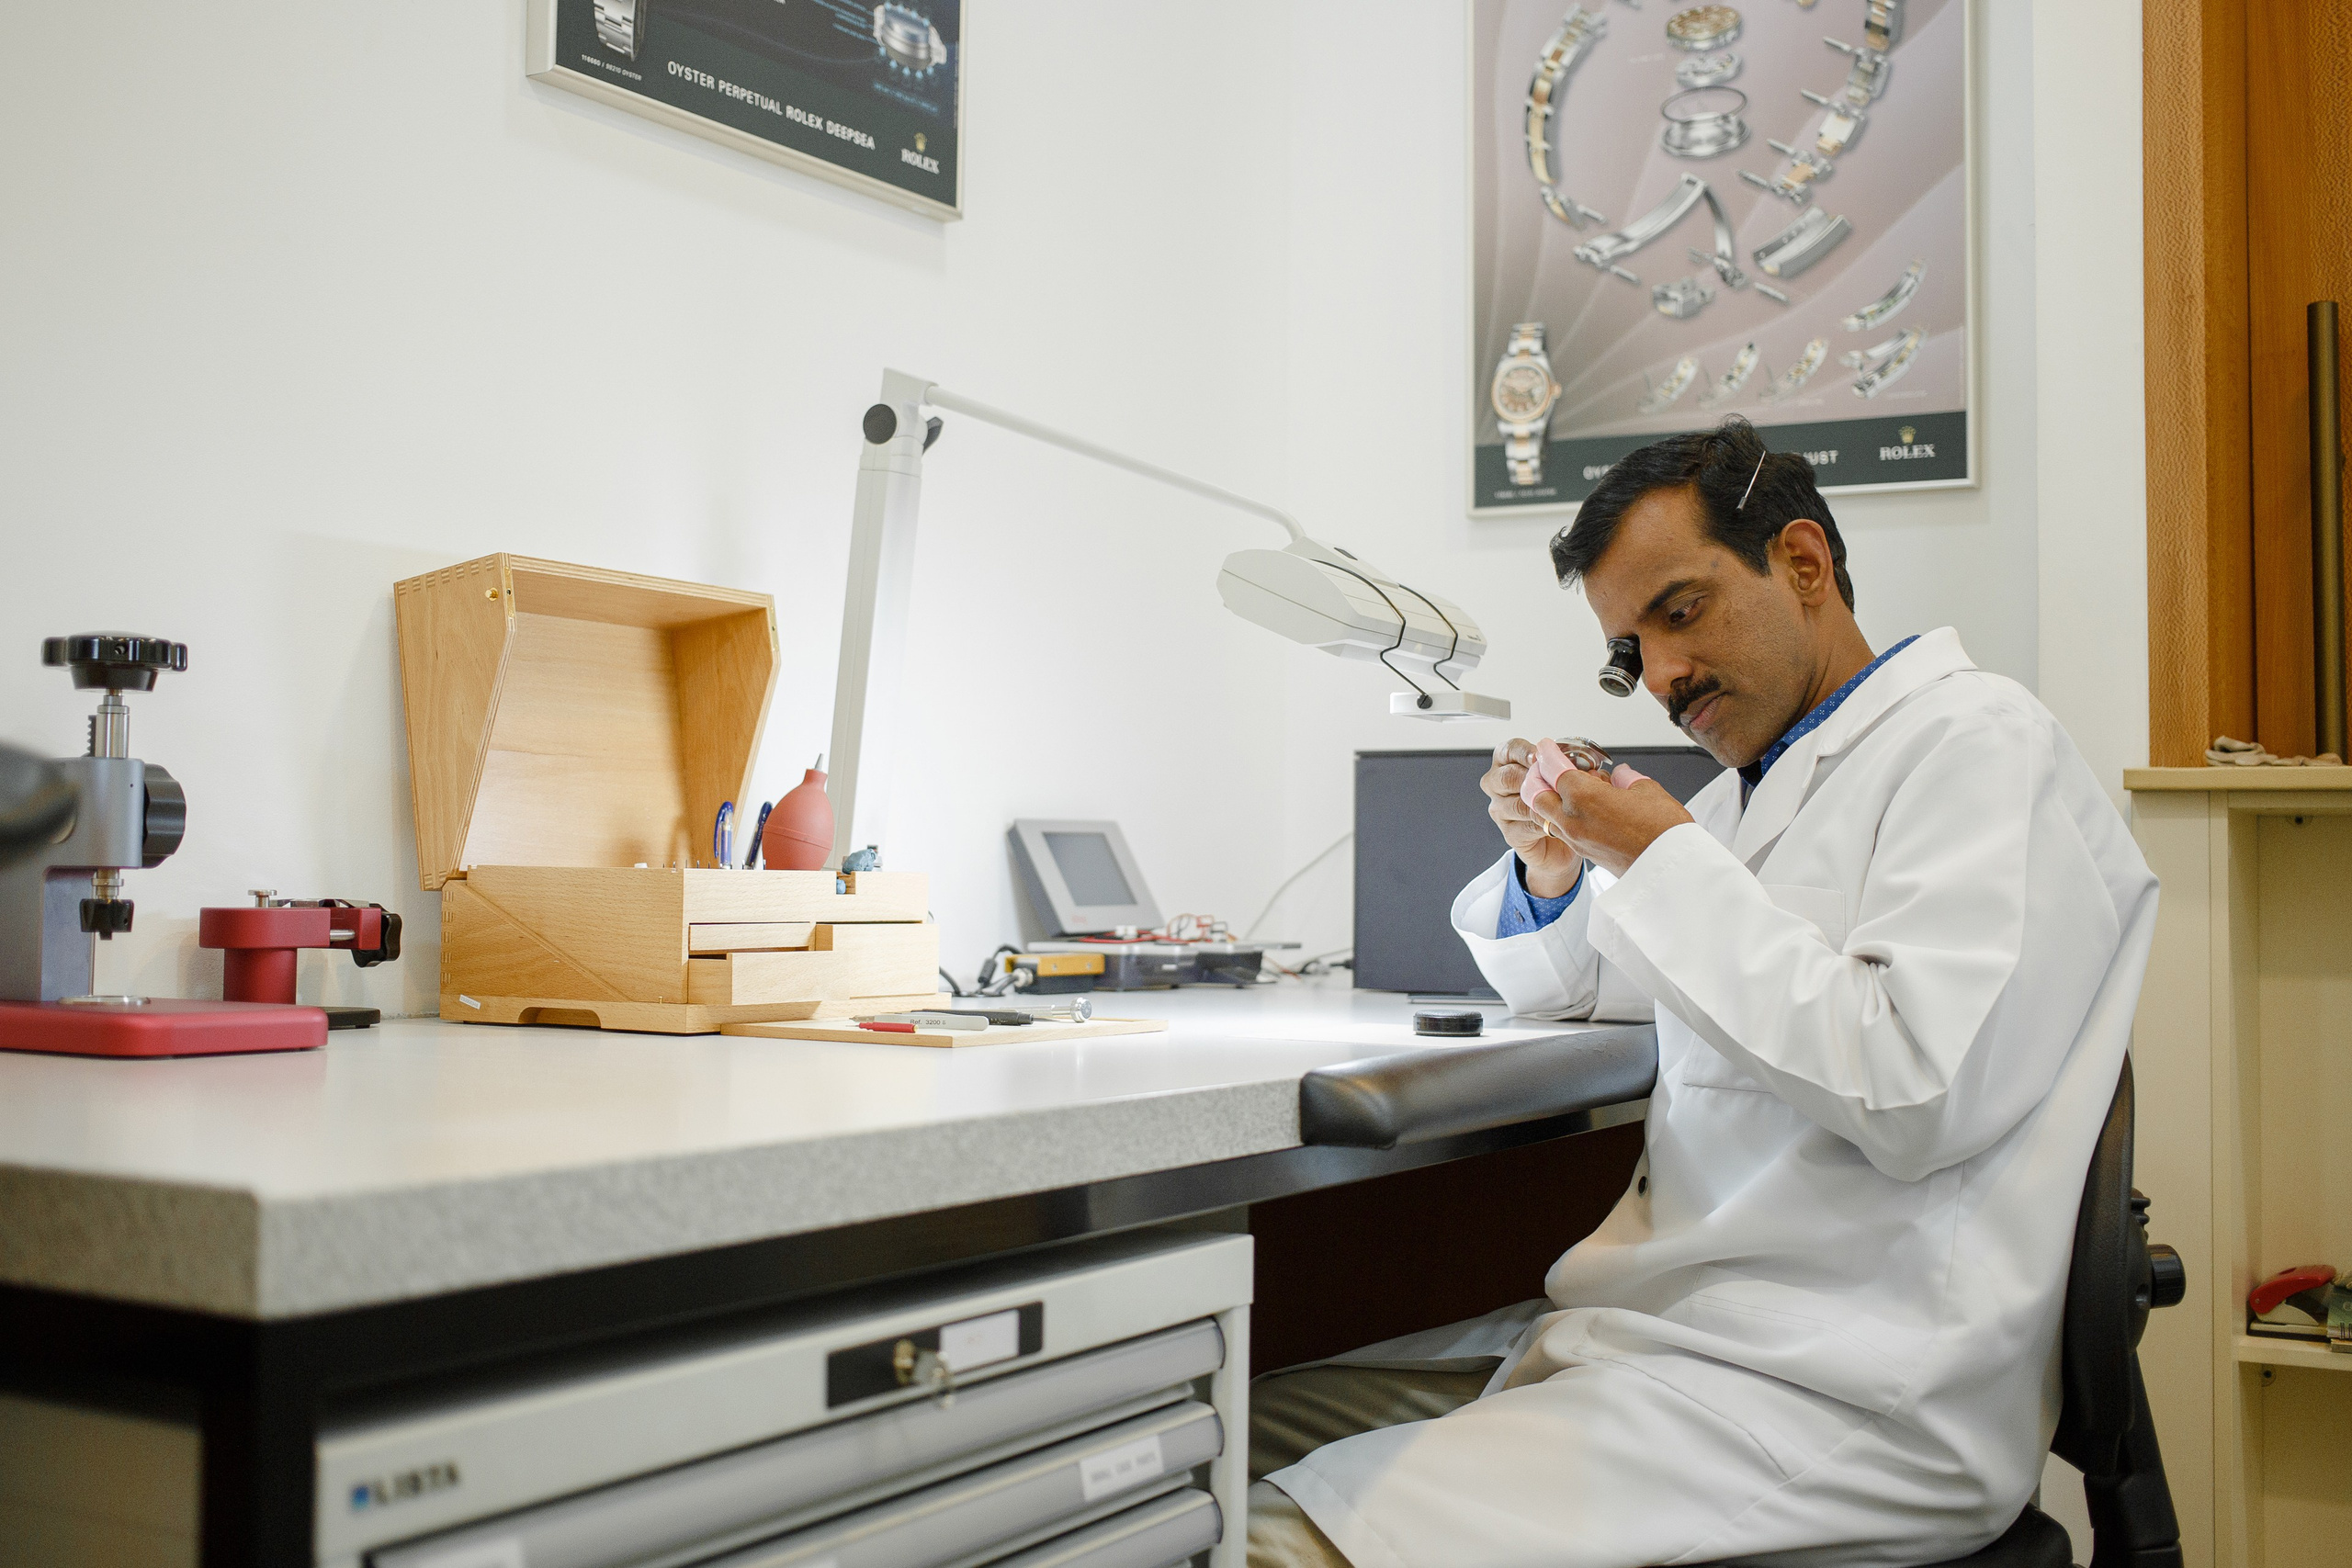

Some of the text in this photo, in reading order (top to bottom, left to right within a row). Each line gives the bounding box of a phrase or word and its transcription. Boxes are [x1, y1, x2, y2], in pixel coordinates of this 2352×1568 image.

[622, 69, 642, 81] OYSTER
[667, 61, 876, 151] OYSTER PERPETUAL ROLEX DEEPSEA
[900, 148, 941, 175] ROLEX
[1879, 444, 1936, 461] ROLEX
